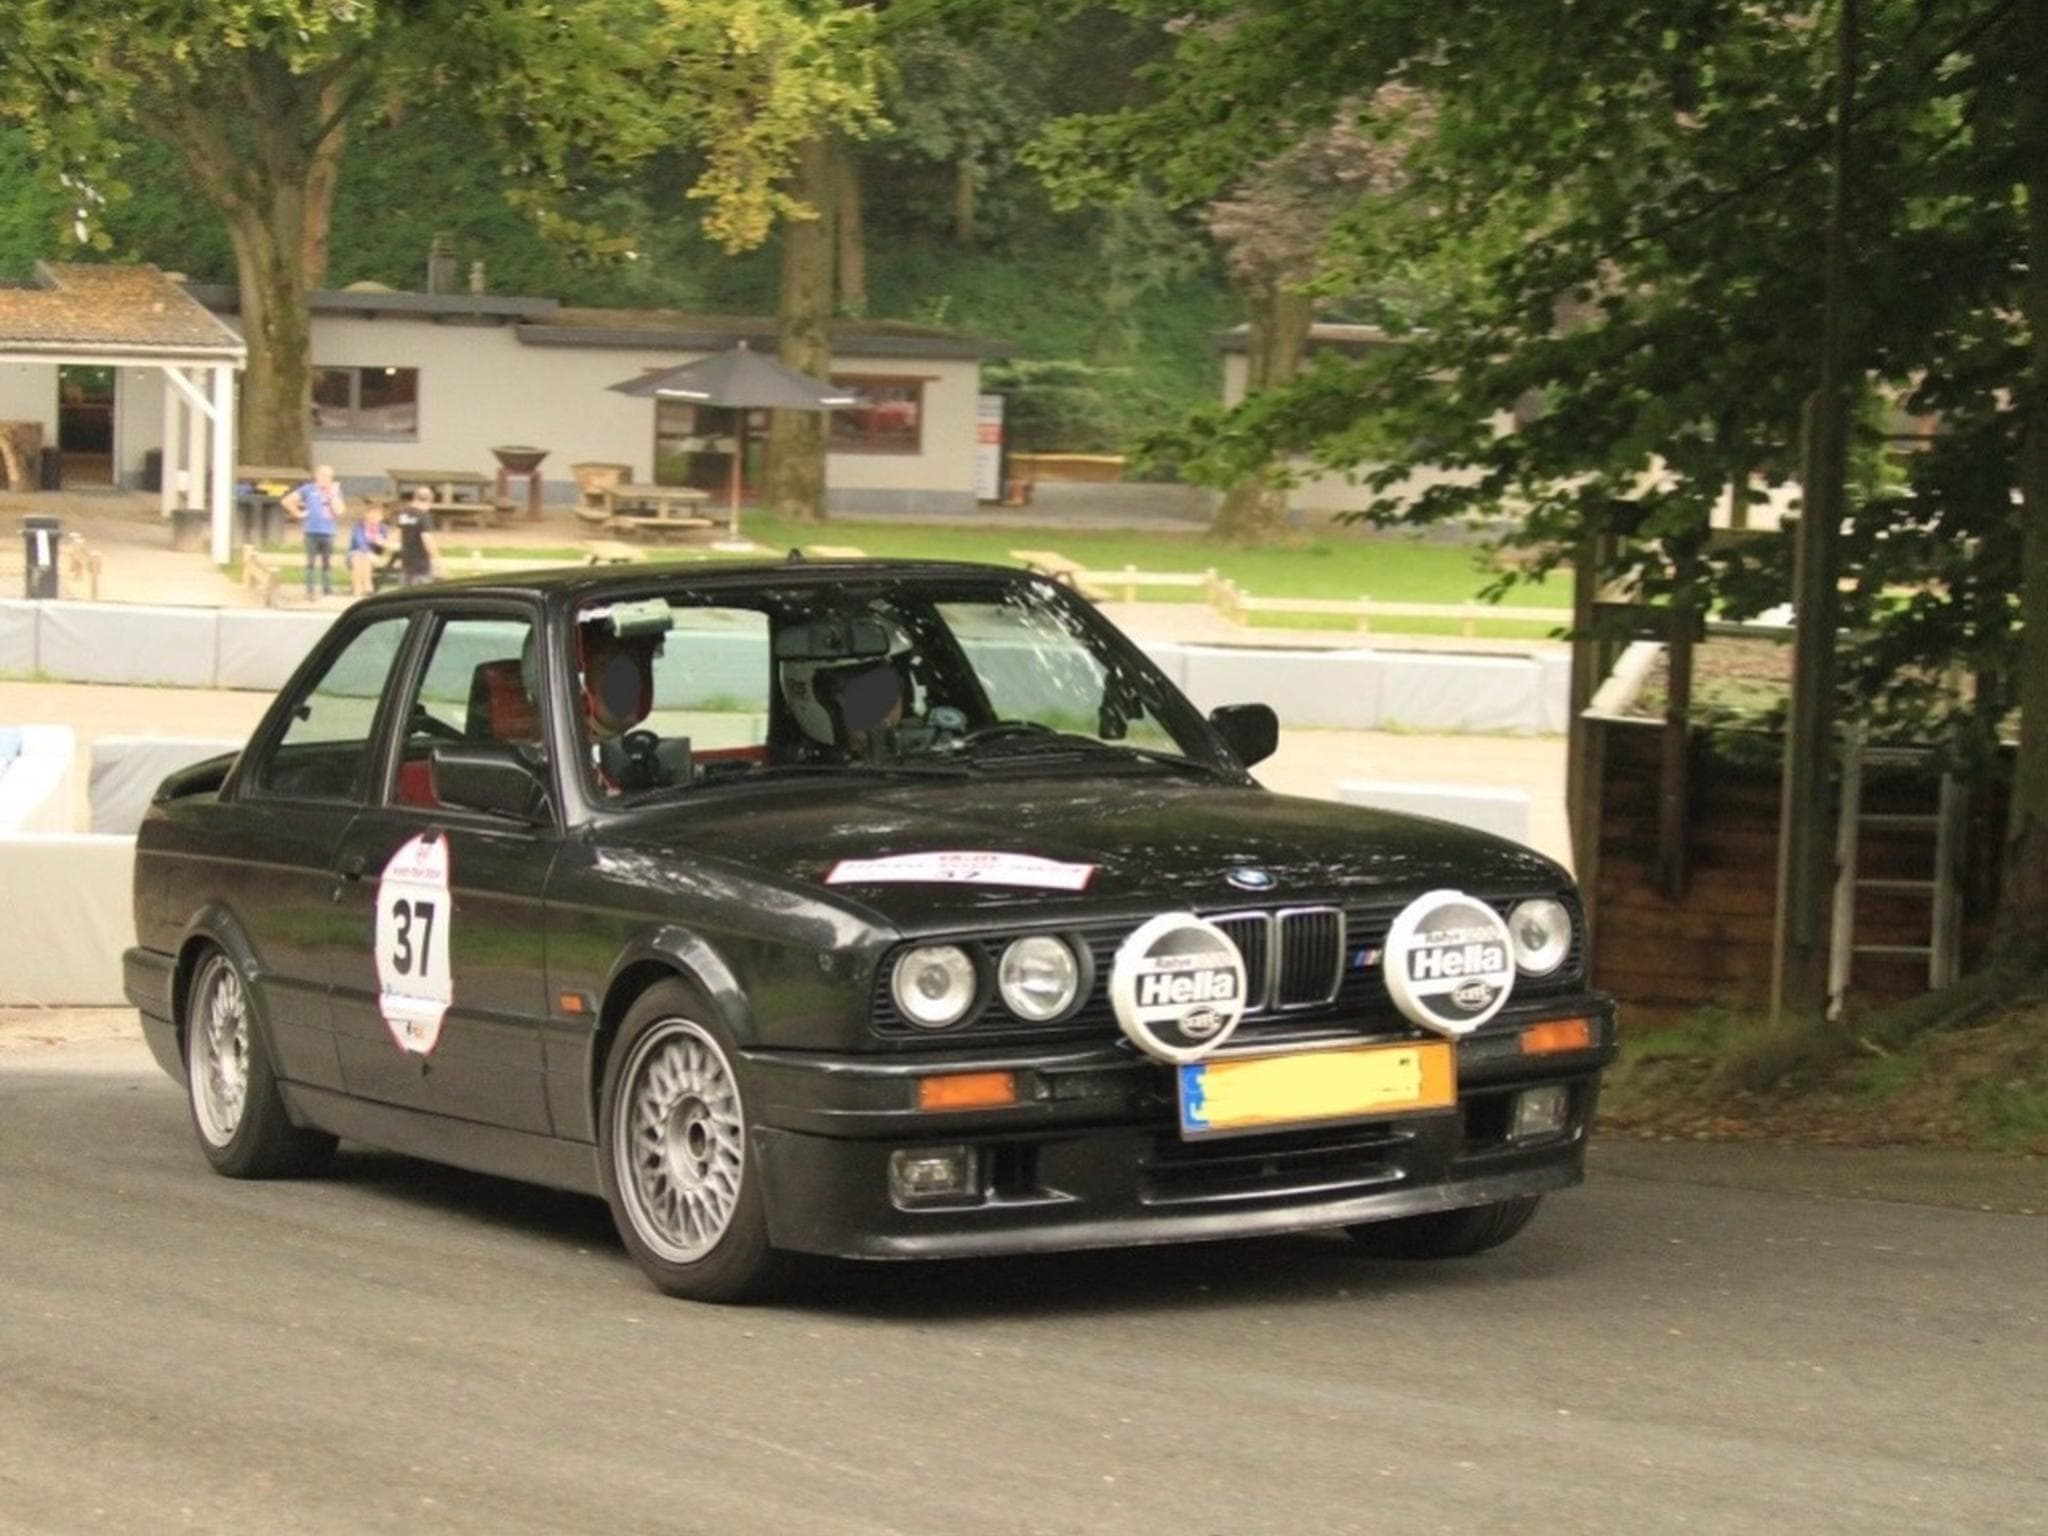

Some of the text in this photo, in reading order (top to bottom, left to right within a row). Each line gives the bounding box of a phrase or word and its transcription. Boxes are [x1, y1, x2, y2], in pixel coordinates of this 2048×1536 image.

[392, 899, 434, 977] 37
[1413, 944, 1503, 979] Hella
[1140, 971, 1235, 1005] Hella
